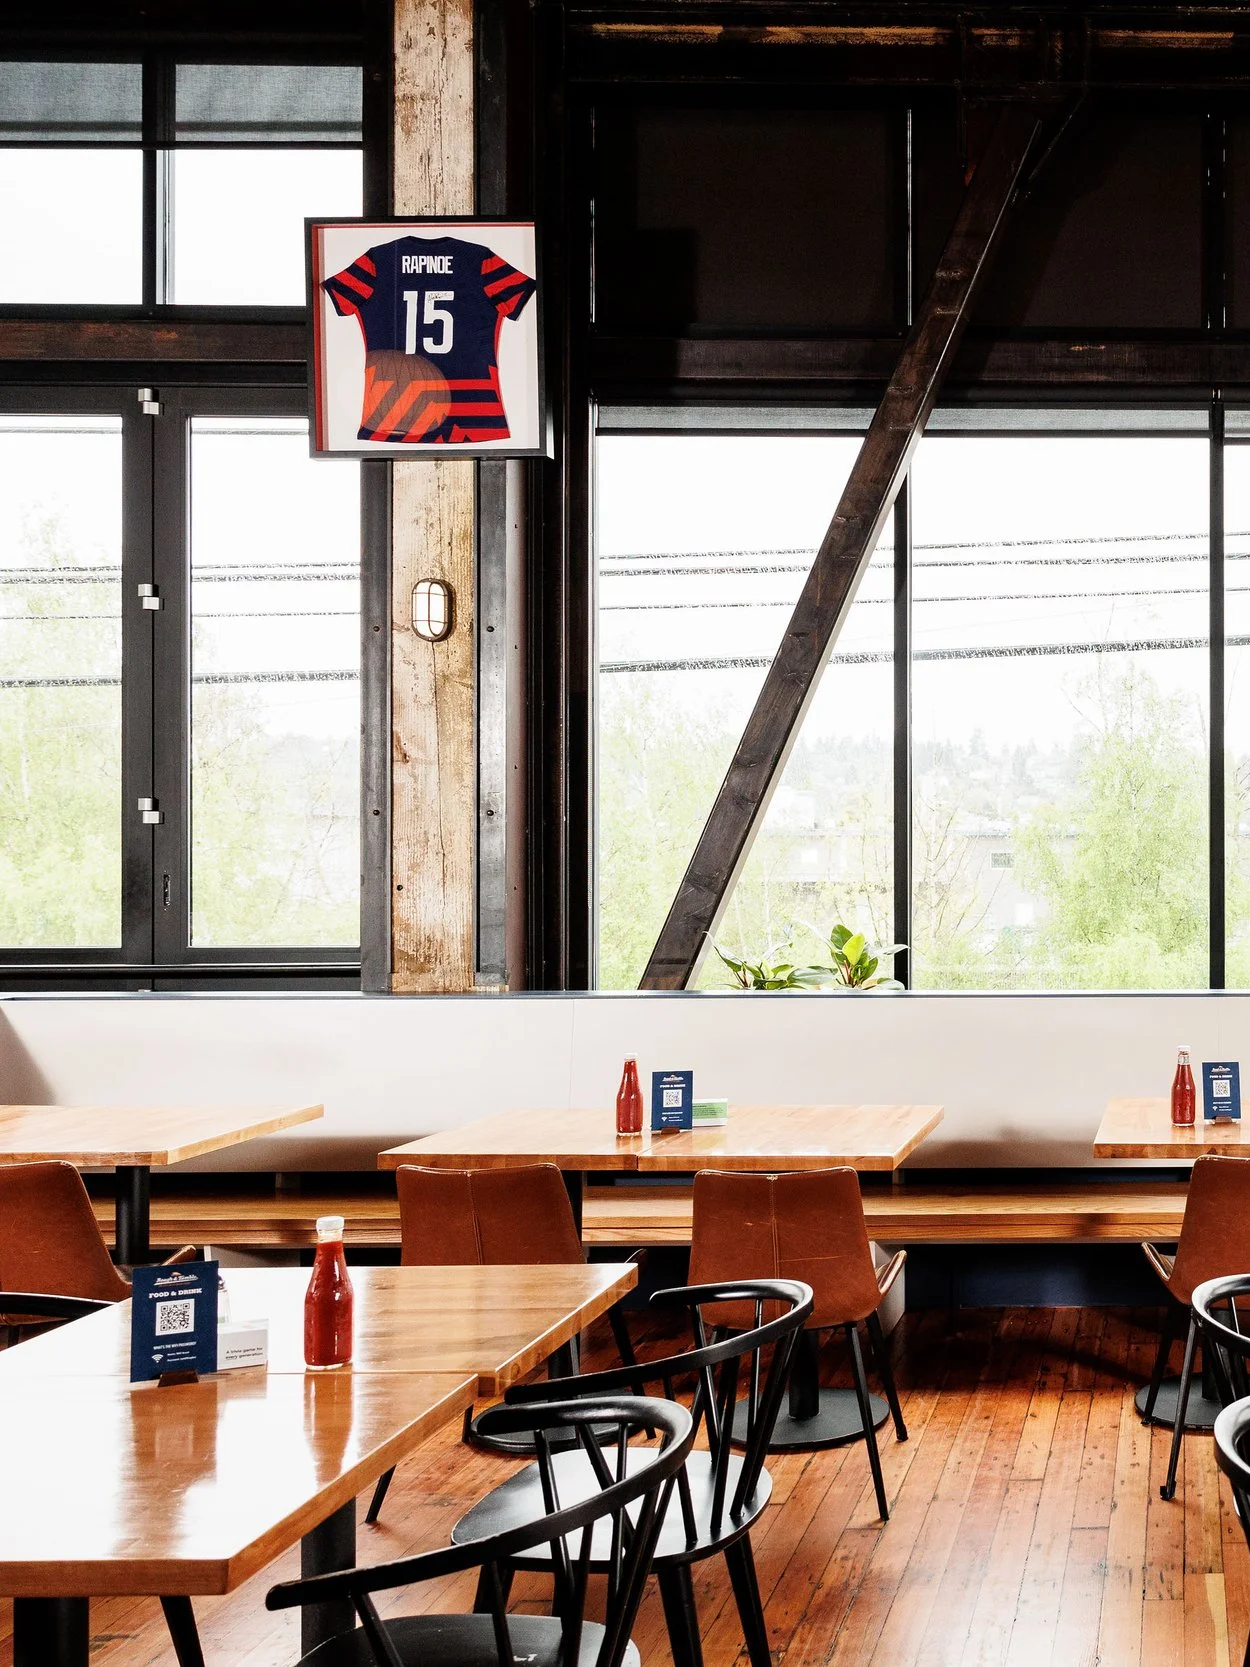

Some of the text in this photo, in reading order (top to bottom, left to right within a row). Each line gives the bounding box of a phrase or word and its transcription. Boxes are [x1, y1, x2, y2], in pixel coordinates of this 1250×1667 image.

[402, 255, 453, 274] RAPINOE
[403, 290, 454, 355] 15
[149, 1291, 170, 1299] FOOD
